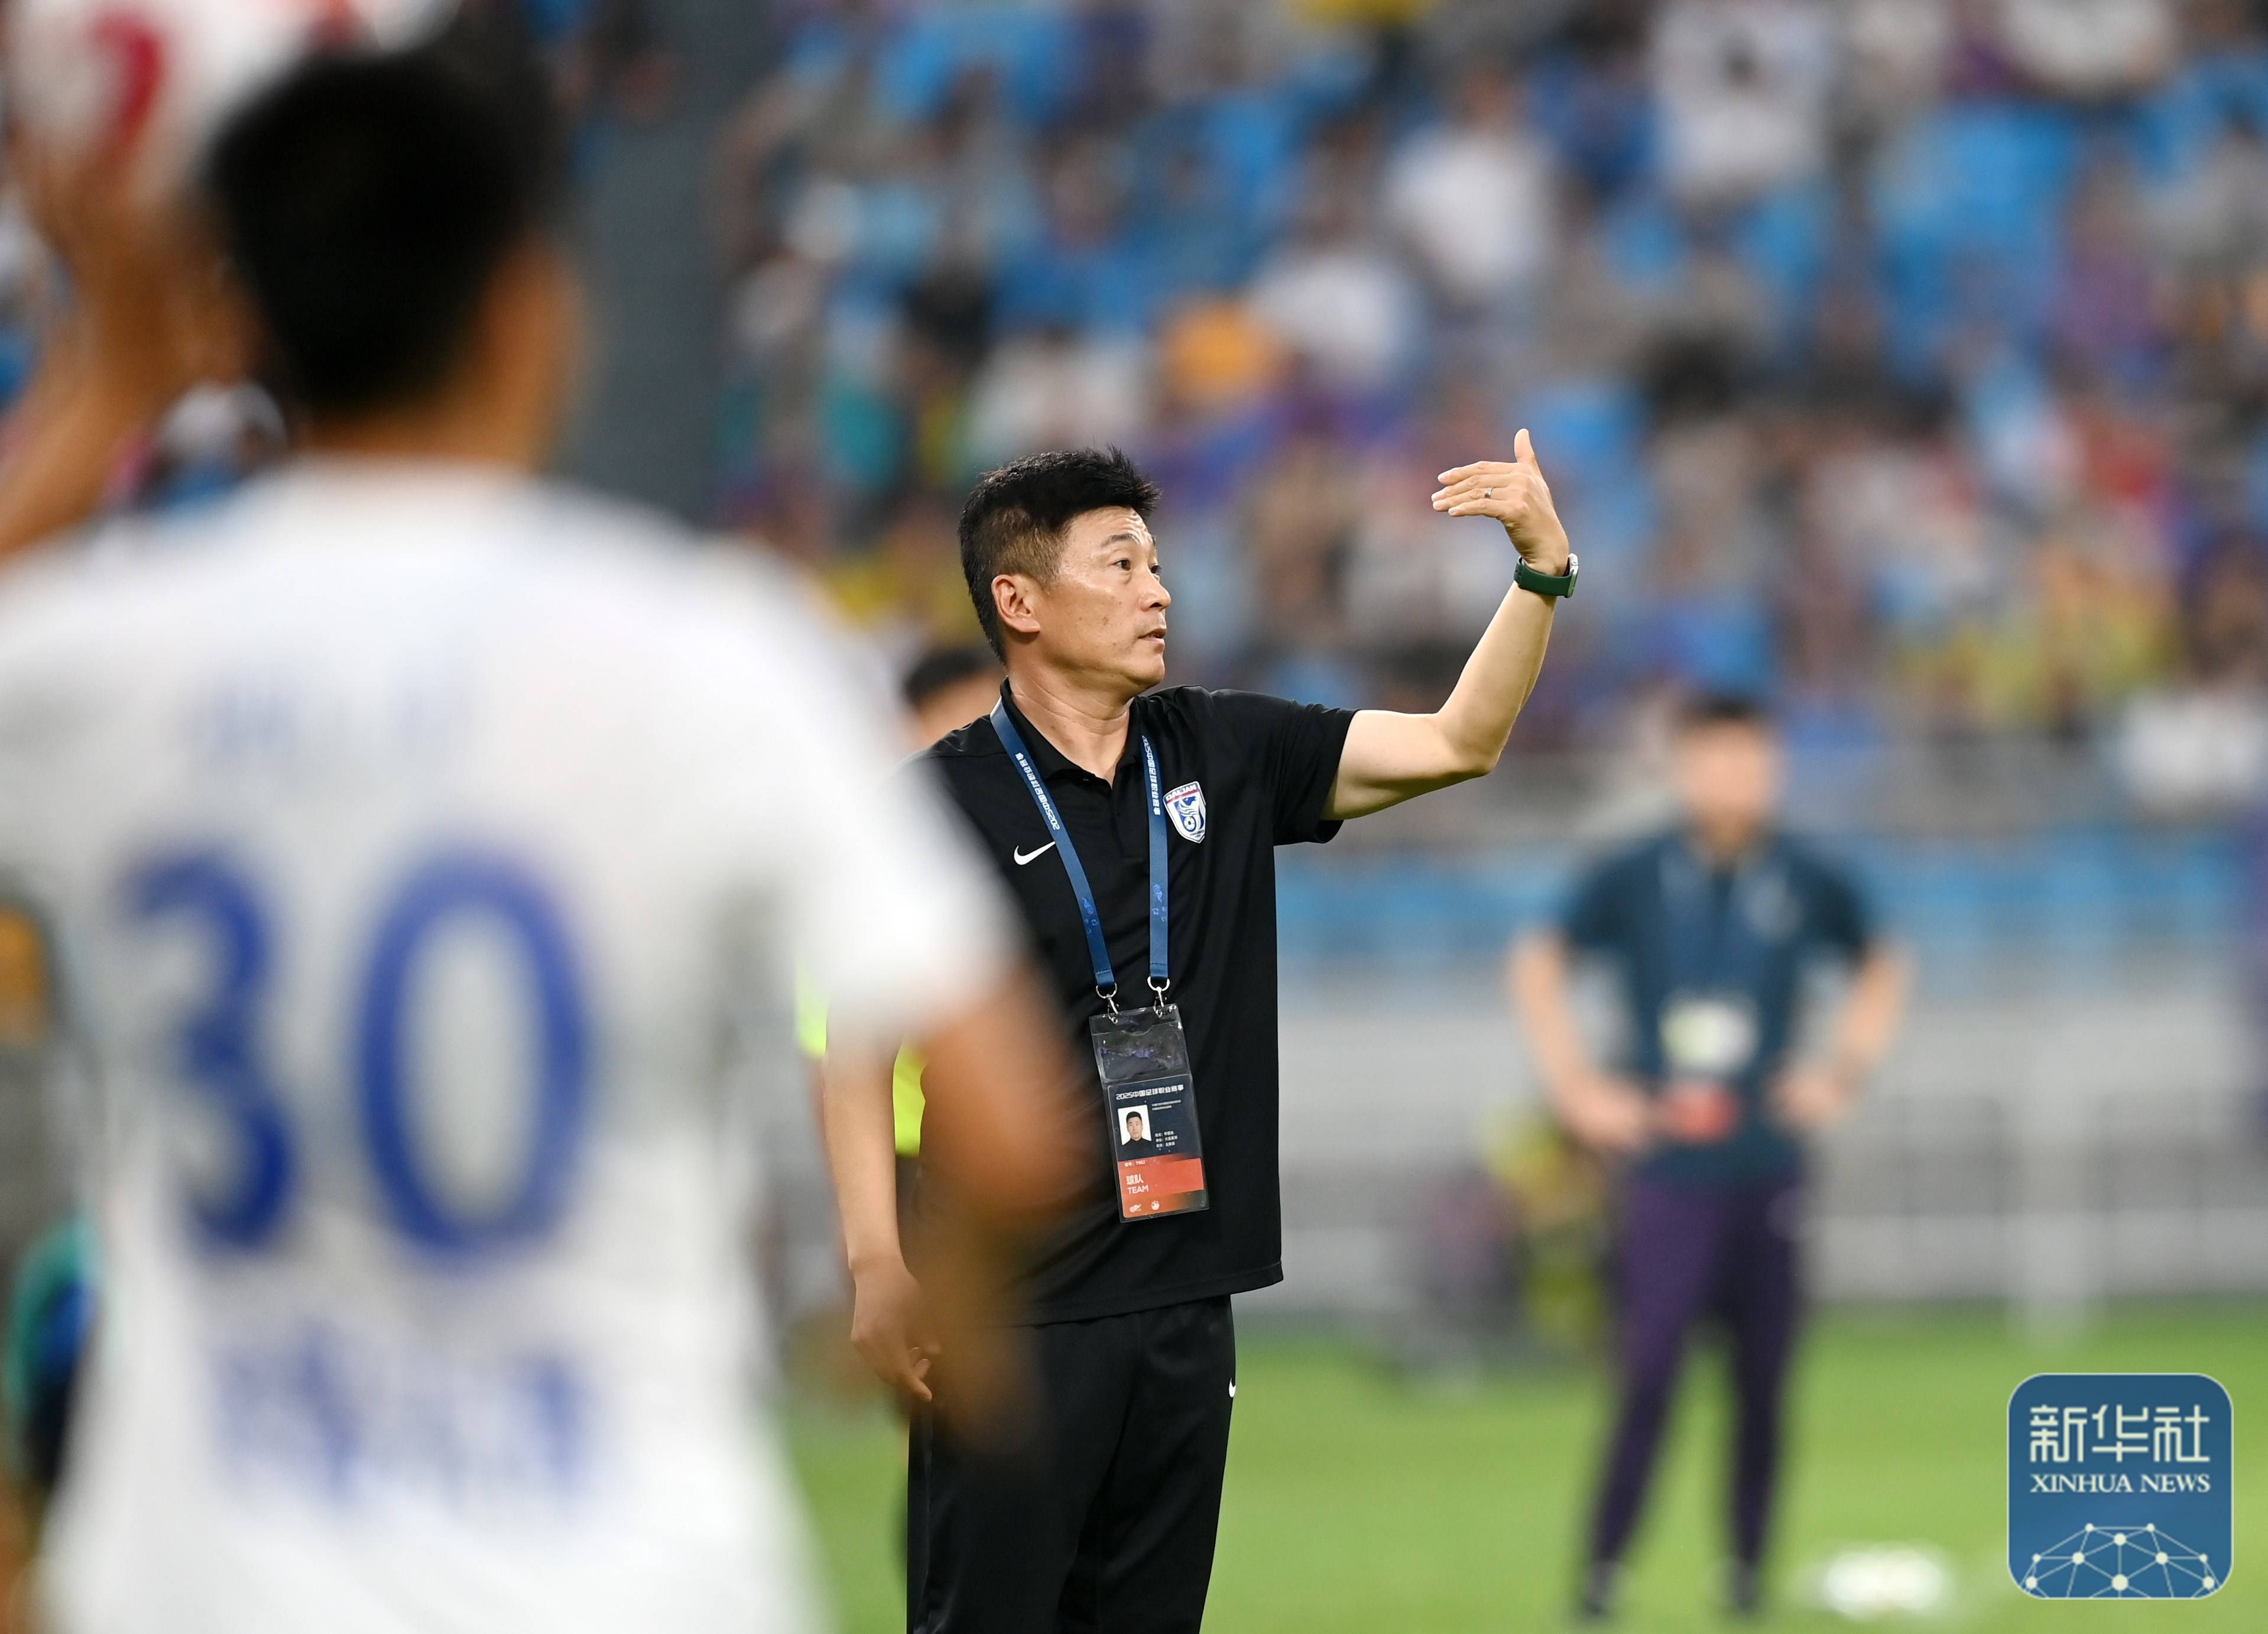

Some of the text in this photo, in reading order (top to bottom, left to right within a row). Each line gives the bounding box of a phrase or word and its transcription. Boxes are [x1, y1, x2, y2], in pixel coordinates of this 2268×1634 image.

[1014, 752, 1060, 830] 2025中国足球职业赛事
[117, 837, 593, 1270] 30
[1127, 1184, 1149, 1194] TEAM
